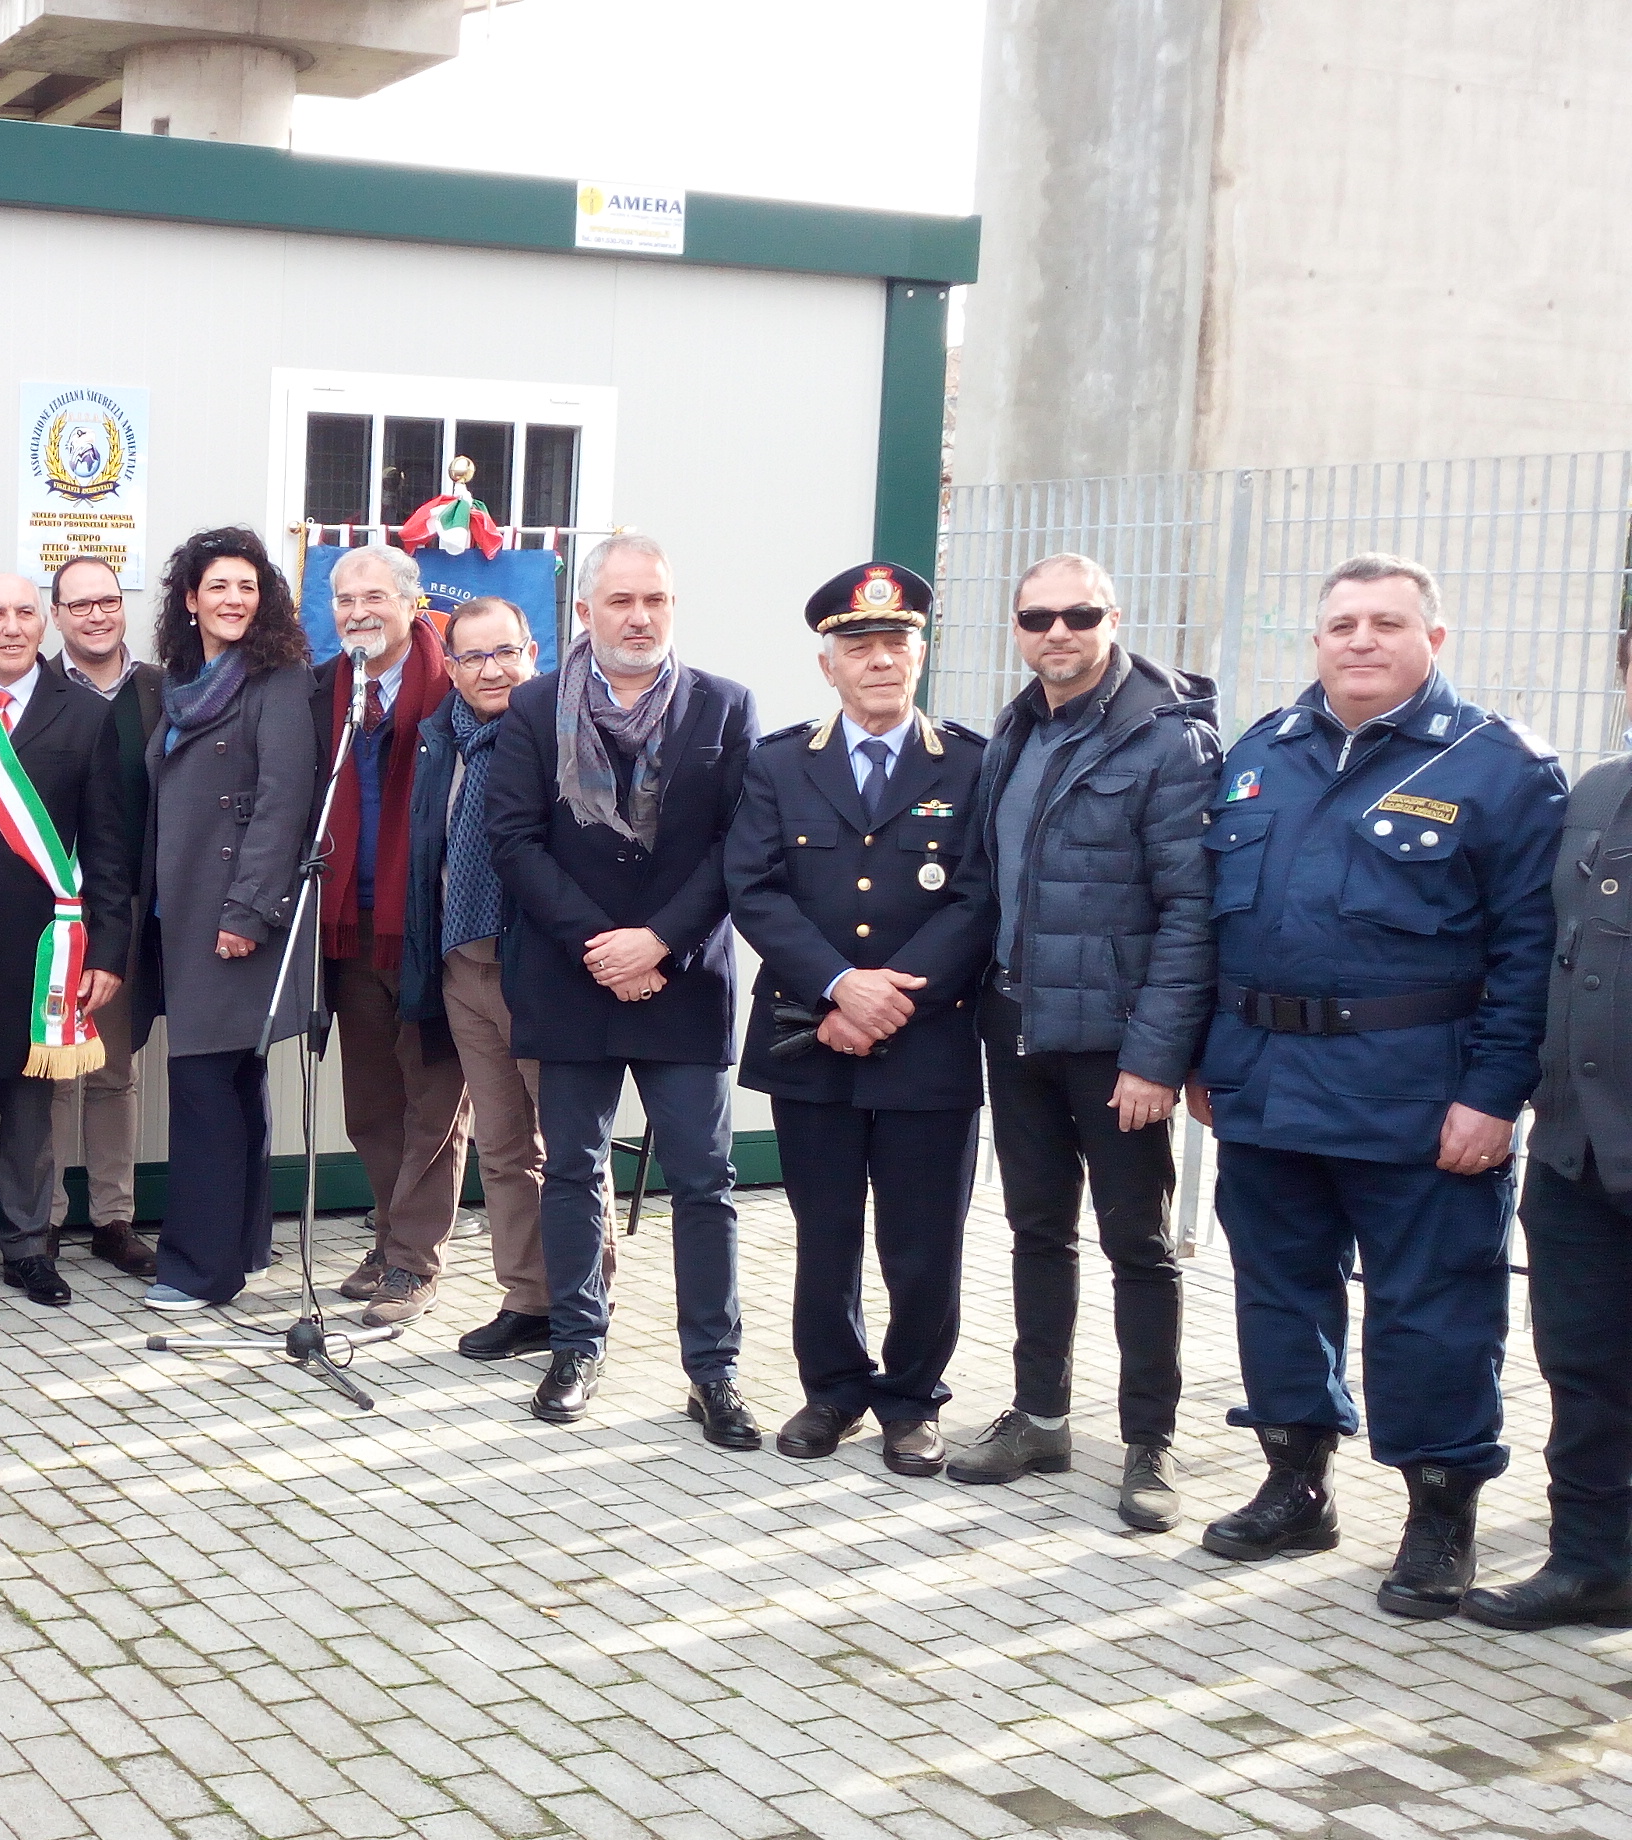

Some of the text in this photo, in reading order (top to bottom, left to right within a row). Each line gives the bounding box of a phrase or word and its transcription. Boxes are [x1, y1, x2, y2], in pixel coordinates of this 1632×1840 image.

[608, 194, 682, 214] AMERA
[30, 388, 136, 482] ASSOCIAZIONE ITALIANA SICUREZZA AMBIENTALE
[58, 512, 98, 520] OPERATIVO
[64, 520, 108, 528] PROVINCIALE
[66, 534, 101, 542] GRUPPO
[42, 544, 70, 552] ITTICO
[78, 544, 127, 552] AMBIENTALE
[430, 582, 477, 600] REGIO
